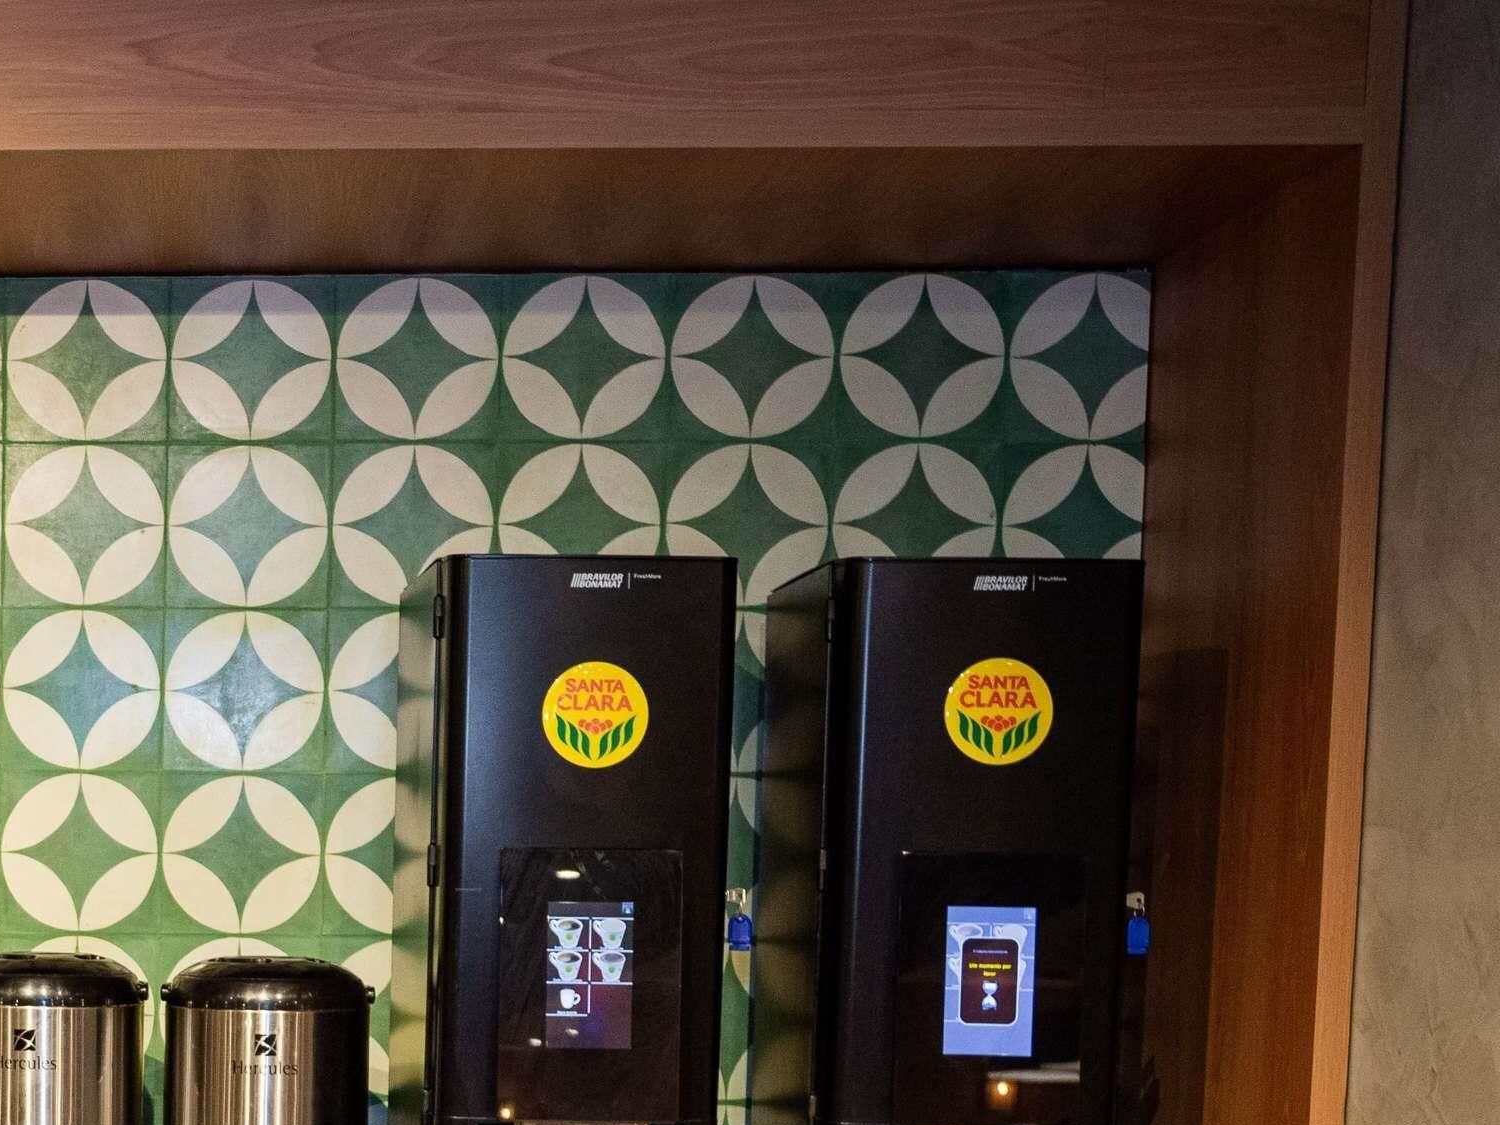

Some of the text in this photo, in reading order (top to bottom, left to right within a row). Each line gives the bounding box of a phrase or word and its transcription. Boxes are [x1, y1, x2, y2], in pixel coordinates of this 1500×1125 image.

[565, 678, 625, 694] SANTA
[968, 674, 1030, 690] SANTA
[557, 693, 633, 712] CLARA
[959, 690, 1038, 709] CLARA
